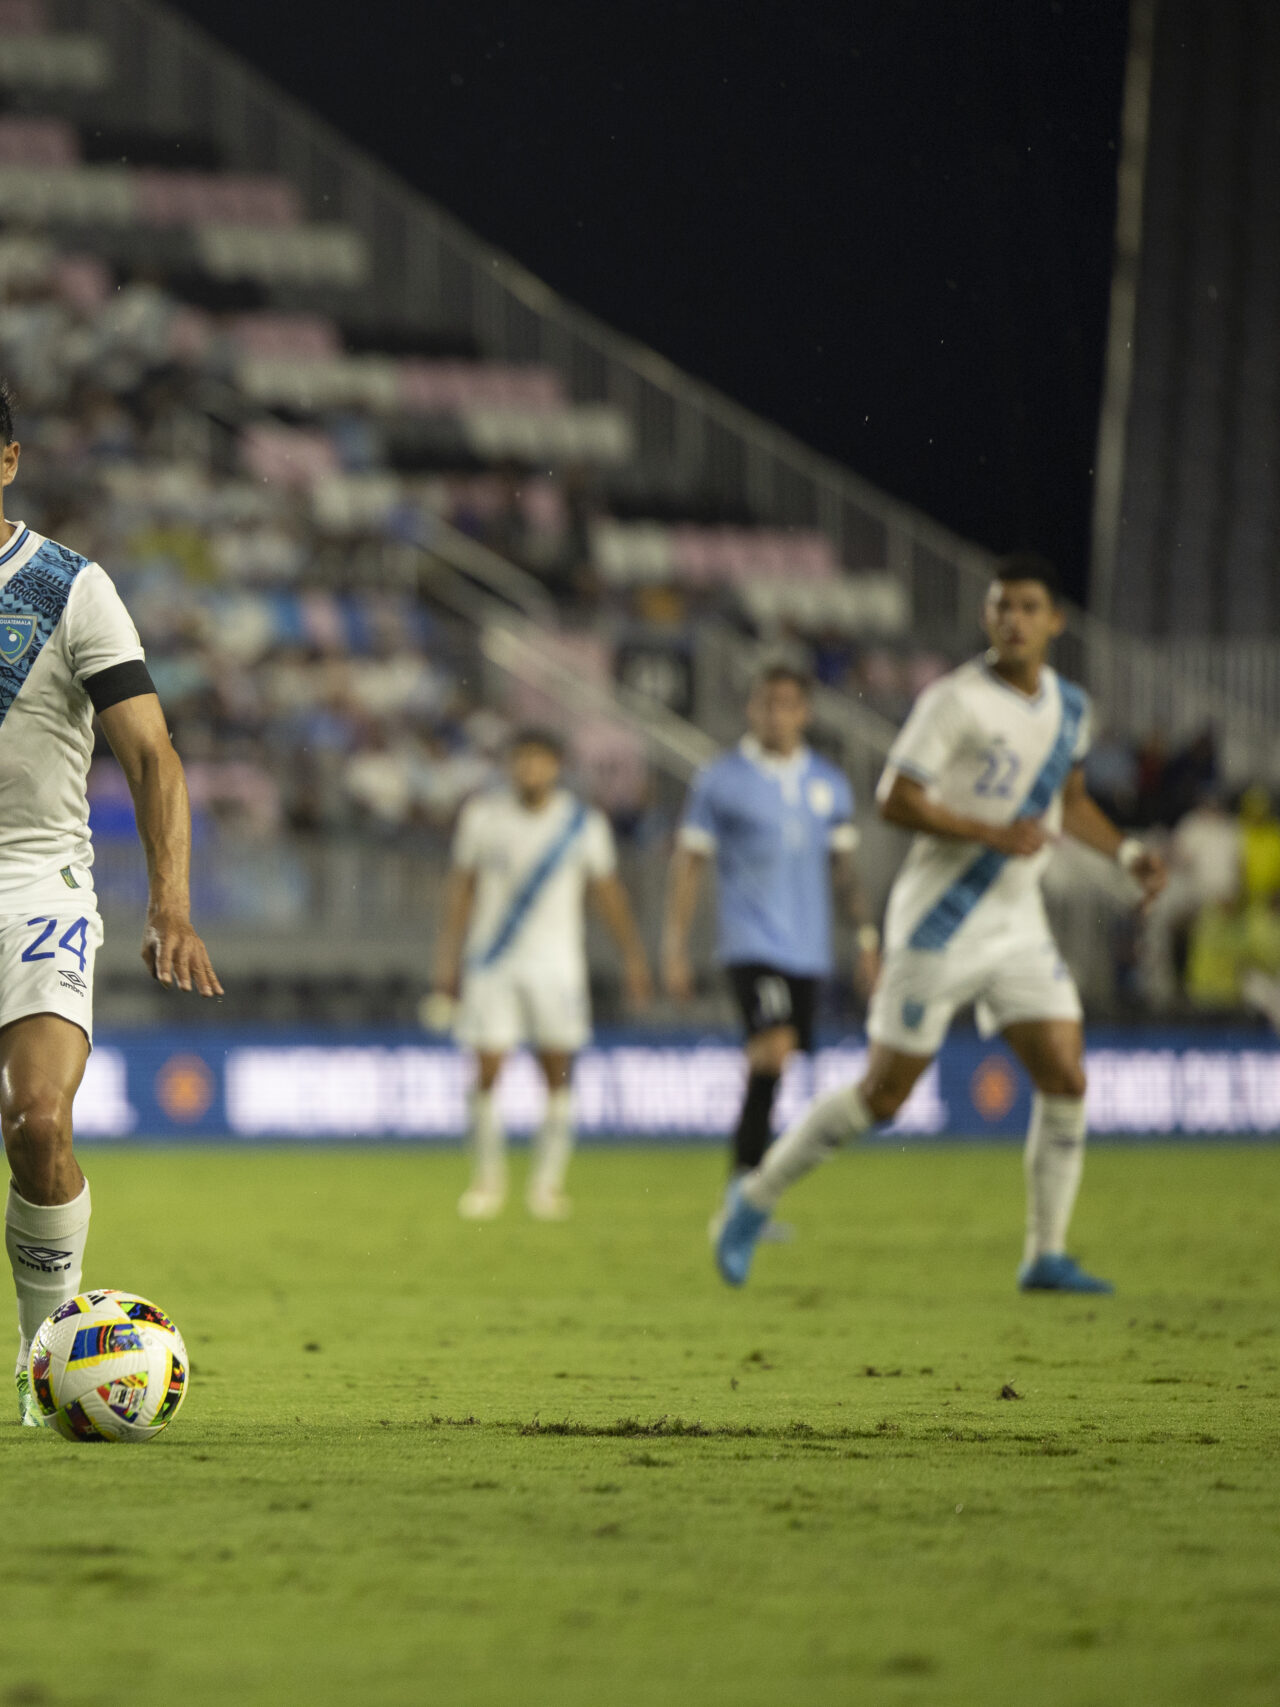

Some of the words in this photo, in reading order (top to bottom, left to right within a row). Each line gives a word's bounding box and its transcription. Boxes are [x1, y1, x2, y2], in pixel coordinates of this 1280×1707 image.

[972, 748, 1022, 799] 22
[21, 915, 90, 972] 24
[17, 1255, 72, 1273] umbro
